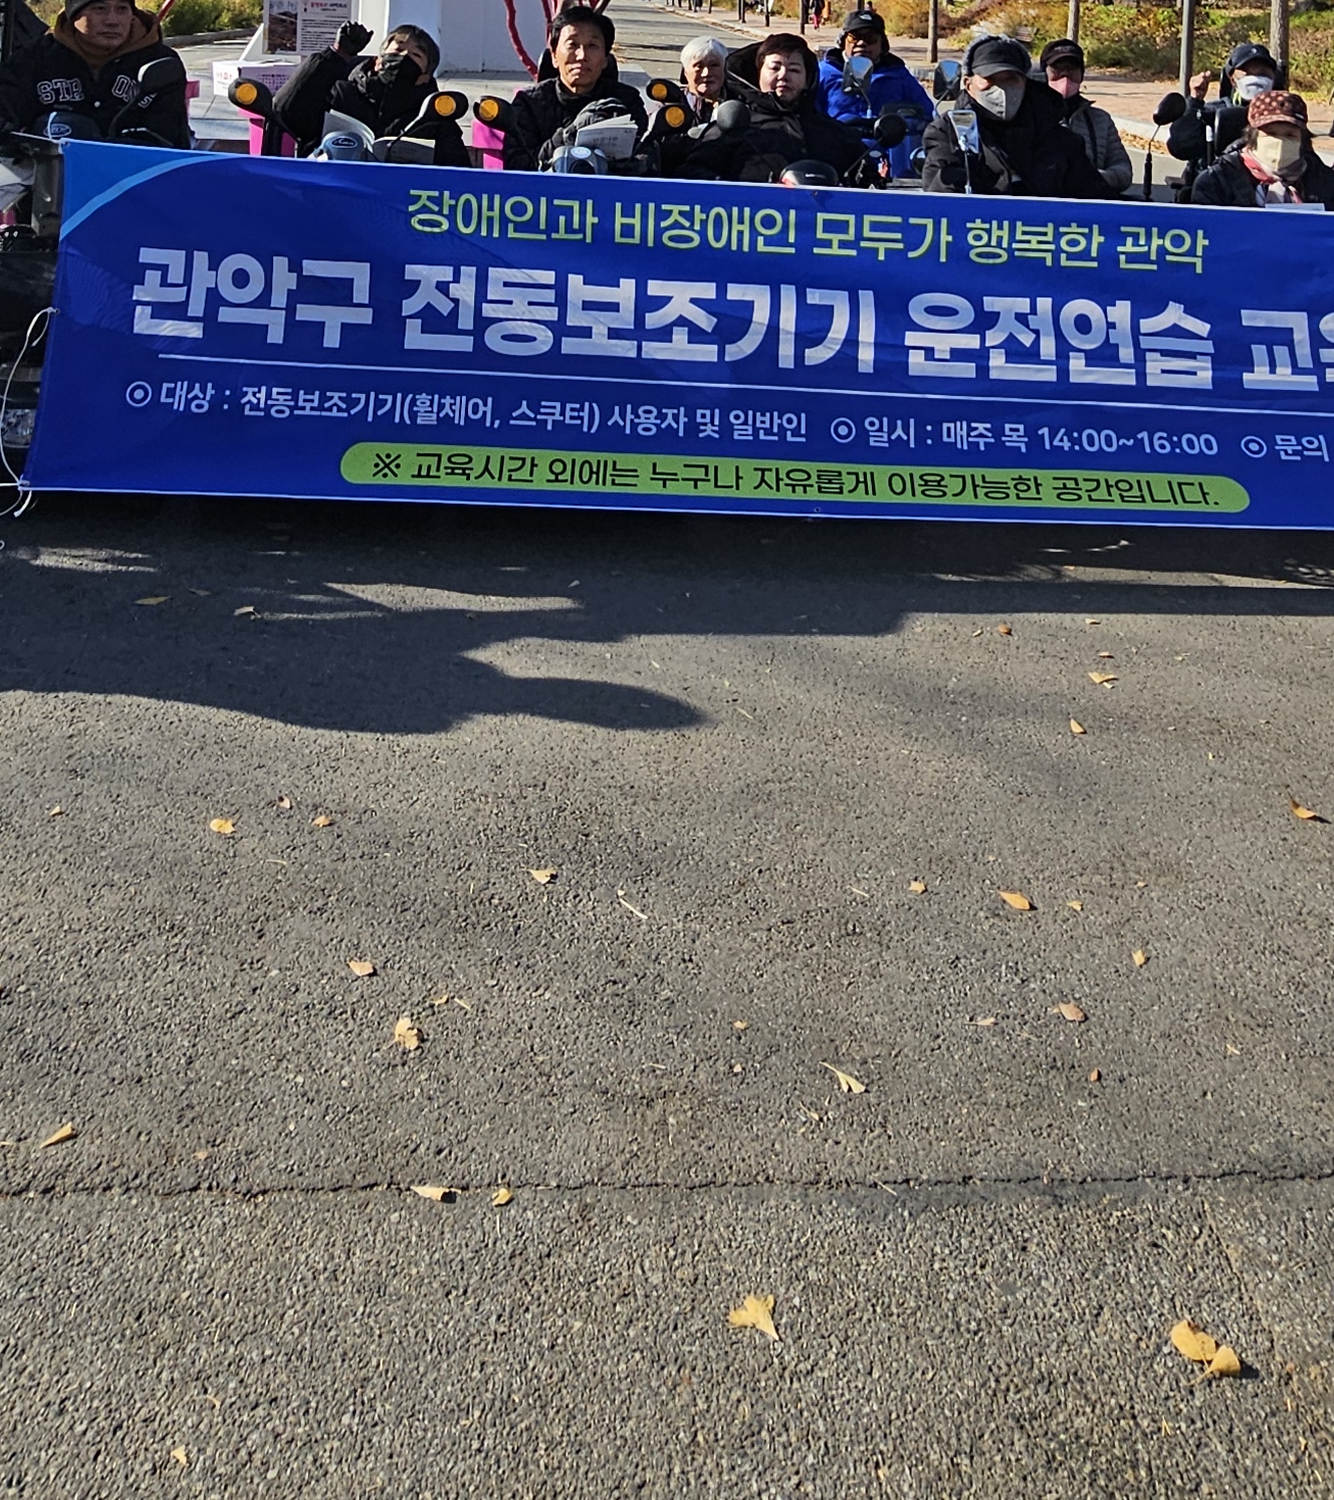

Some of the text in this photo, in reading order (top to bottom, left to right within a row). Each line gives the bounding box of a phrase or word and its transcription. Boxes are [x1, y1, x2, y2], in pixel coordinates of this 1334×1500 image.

[408, 189, 1210, 274] 장애인과 비장애인 모두가 행복한 관악
[131, 246, 374, 349] 관악구
[400, 264, 876, 373] 전동보조기기
[904, 292, 1215, 390] 운전연습
[160, 380, 216, 414] 대상
[240, 385, 501, 429] 전동보조기기(휠체어,
[509, 400, 600, 434] 스쿠터)
[607, 404, 689, 437] 사용자
[695, 409, 720, 439] 및
[729, 409, 807, 442] 일반인
[864, 416, 915, 449] 일시
[942, 420, 995, 451] 매주
[1001, 423, 1028, 453] 목
[1037, 426, 1219, 455] 14:00~16:00
[1274, 434, 1330, 463] 문의
[410, 452, 539, 484] 교육시간
[545, 457, 640, 488] 외에는
[649, 461, 744, 491] 누구나
[752, 464, 877, 496] 자유롭게
[887, 469, 1044, 502] 이용가능한
[1052, 475, 1221, 507] 공간입니다.
